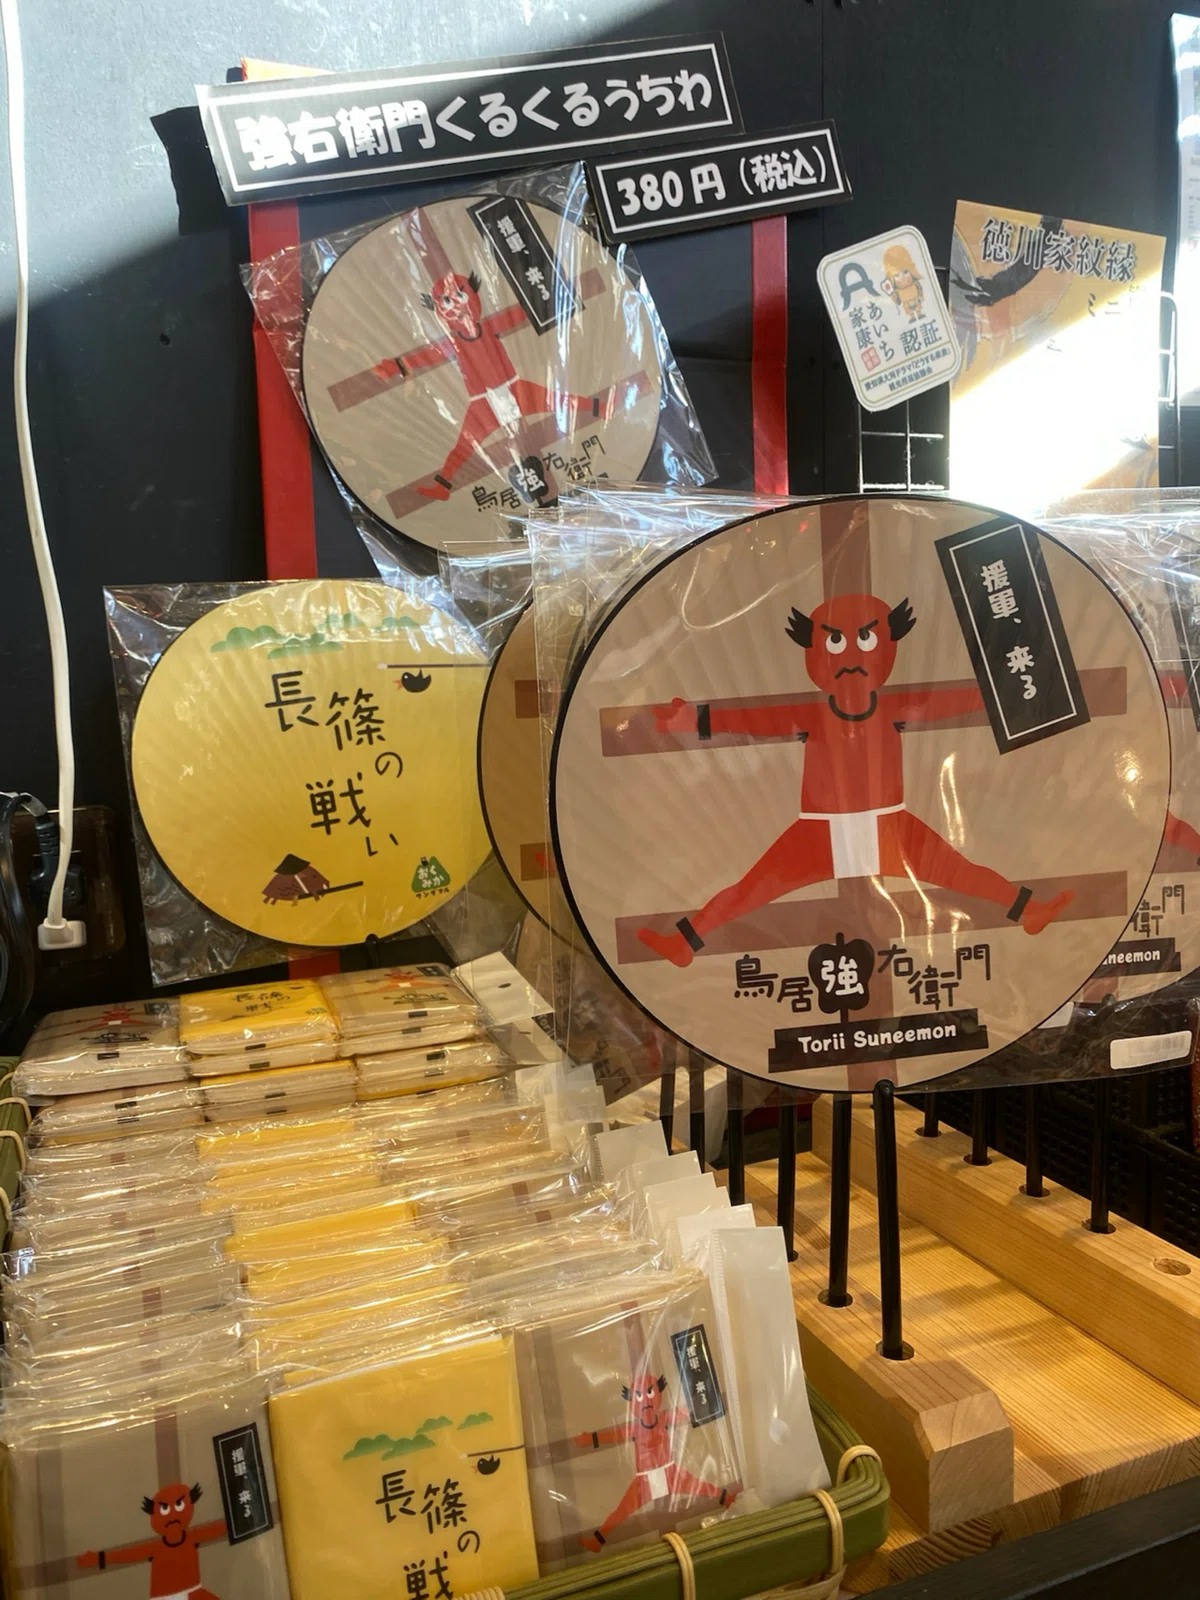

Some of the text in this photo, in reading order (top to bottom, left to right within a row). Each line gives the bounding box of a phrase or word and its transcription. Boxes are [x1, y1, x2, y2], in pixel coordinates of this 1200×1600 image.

[234, 69, 713, 172] 強右衛門くるくるうちわ
[981, 215, 1137, 283] 徳川家紋縁
[849, 307, 875, 349] 家康
[866, 301, 895, 362] あいち
[900, 318, 943, 356] 認証
[980, 559, 1038, 700] 援軍、来る
[734, 943, 991, 1013] 鳥居強右衛門
[798, 1024, 957, 1054] Torii Suneemon
